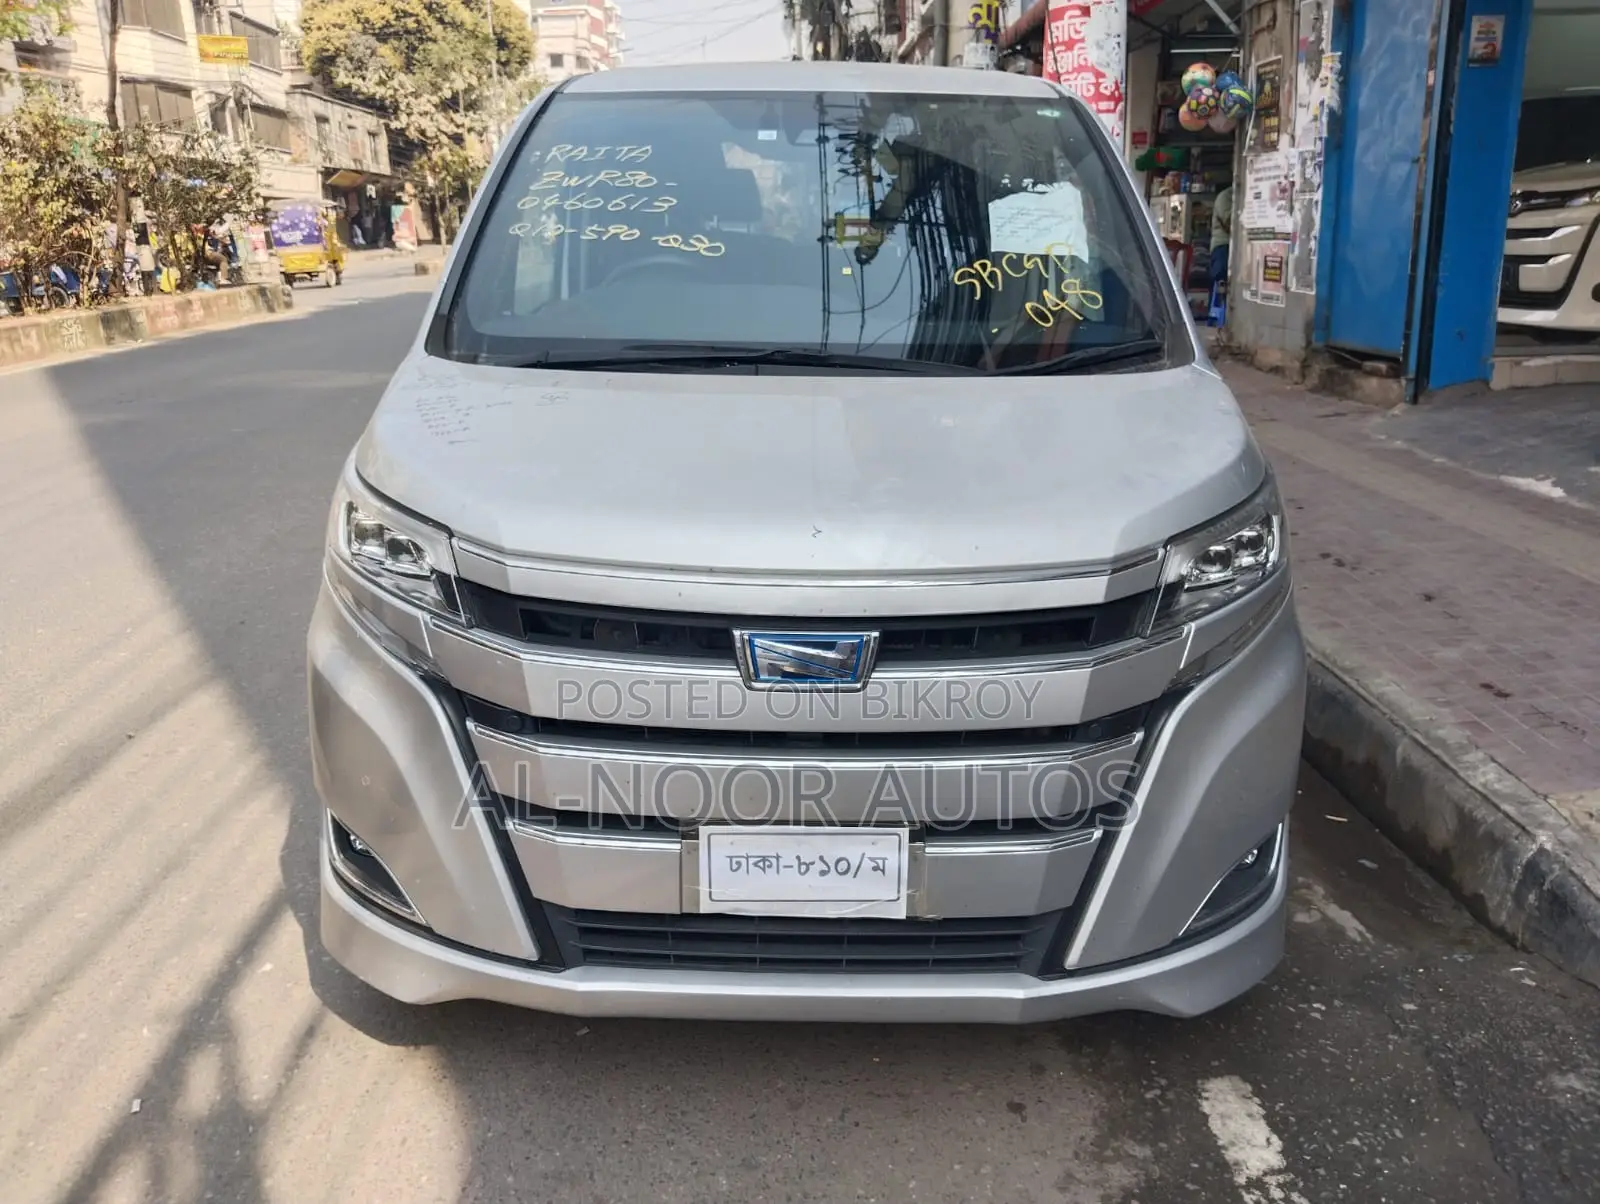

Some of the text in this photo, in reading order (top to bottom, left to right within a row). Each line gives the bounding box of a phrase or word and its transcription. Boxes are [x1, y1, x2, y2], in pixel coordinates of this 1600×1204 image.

[546, 144, 653, 163] RAITA
[516, 192, 678, 213] 0460613
[1024, 278, 1104, 328] 048
